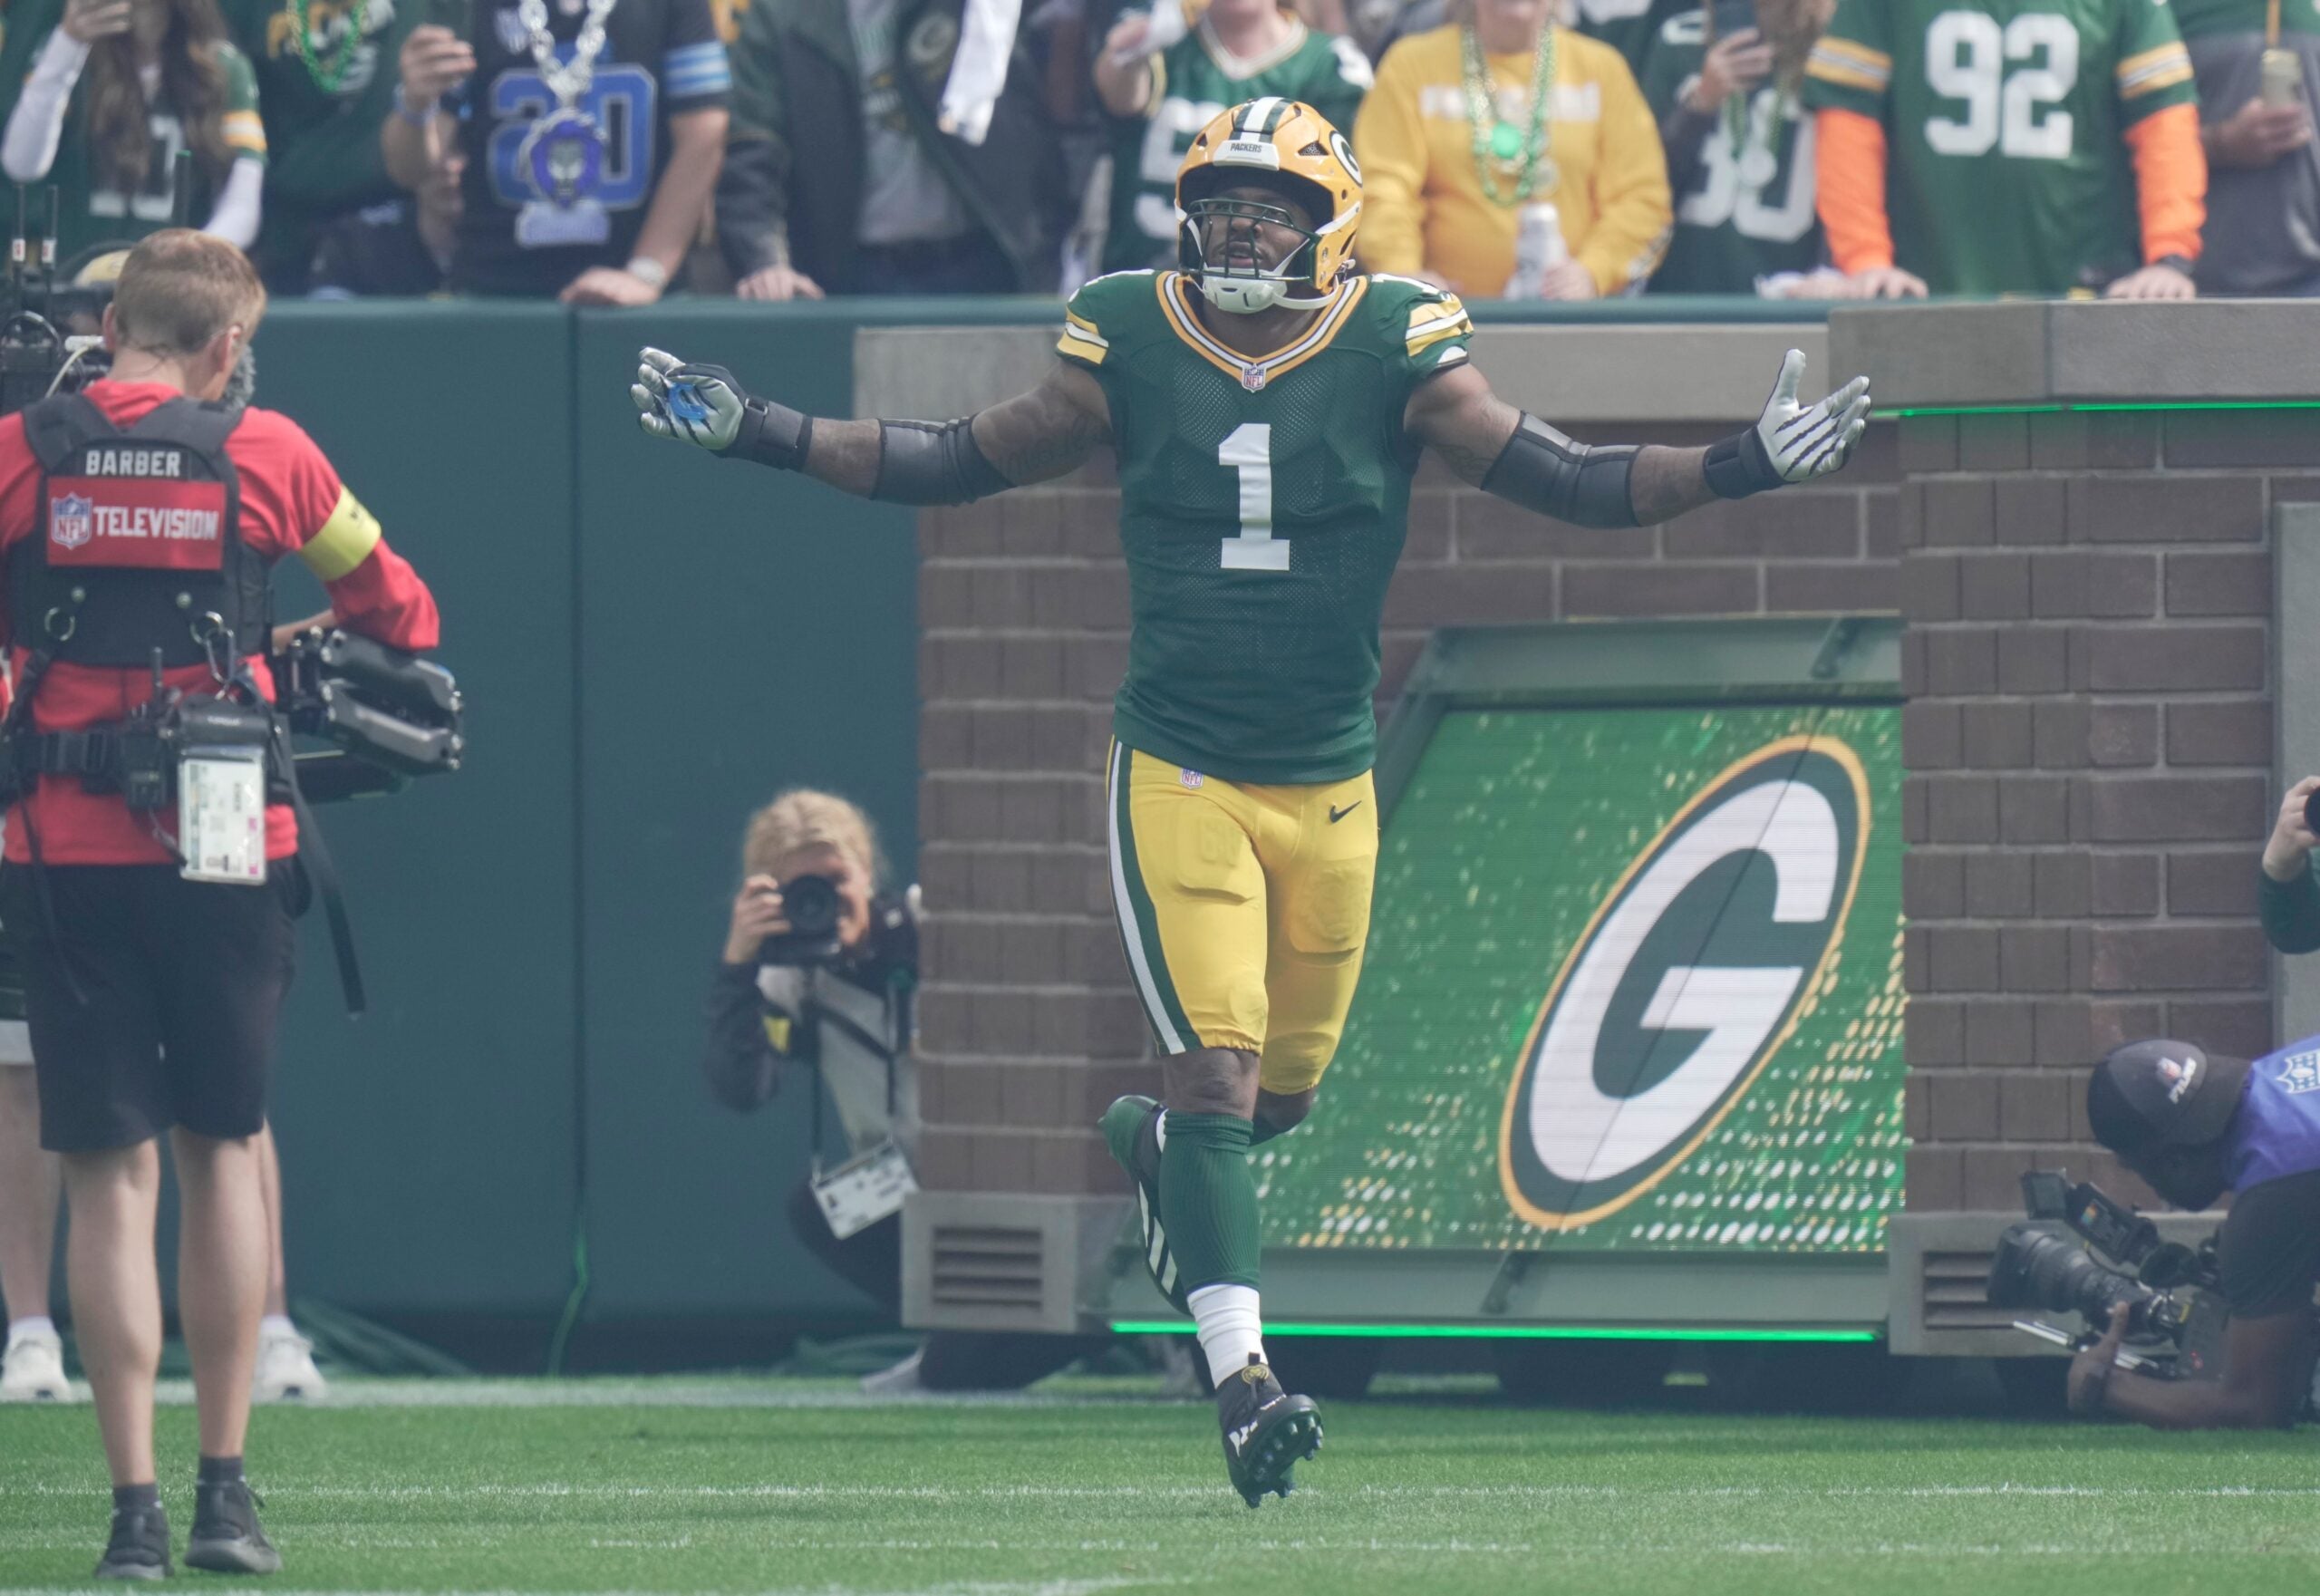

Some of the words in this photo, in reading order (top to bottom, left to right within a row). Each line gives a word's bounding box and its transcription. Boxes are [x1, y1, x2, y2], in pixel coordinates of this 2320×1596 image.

[1924, 9, 2080, 160] 92
[1230, 142, 1263, 153] PACKERS
[85, 450, 180, 477] BARBER
[1219, 422, 1290, 571] 1
[92, 506, 219, 540] TELEVISION
[1530, 779, 1840, 1183] G
